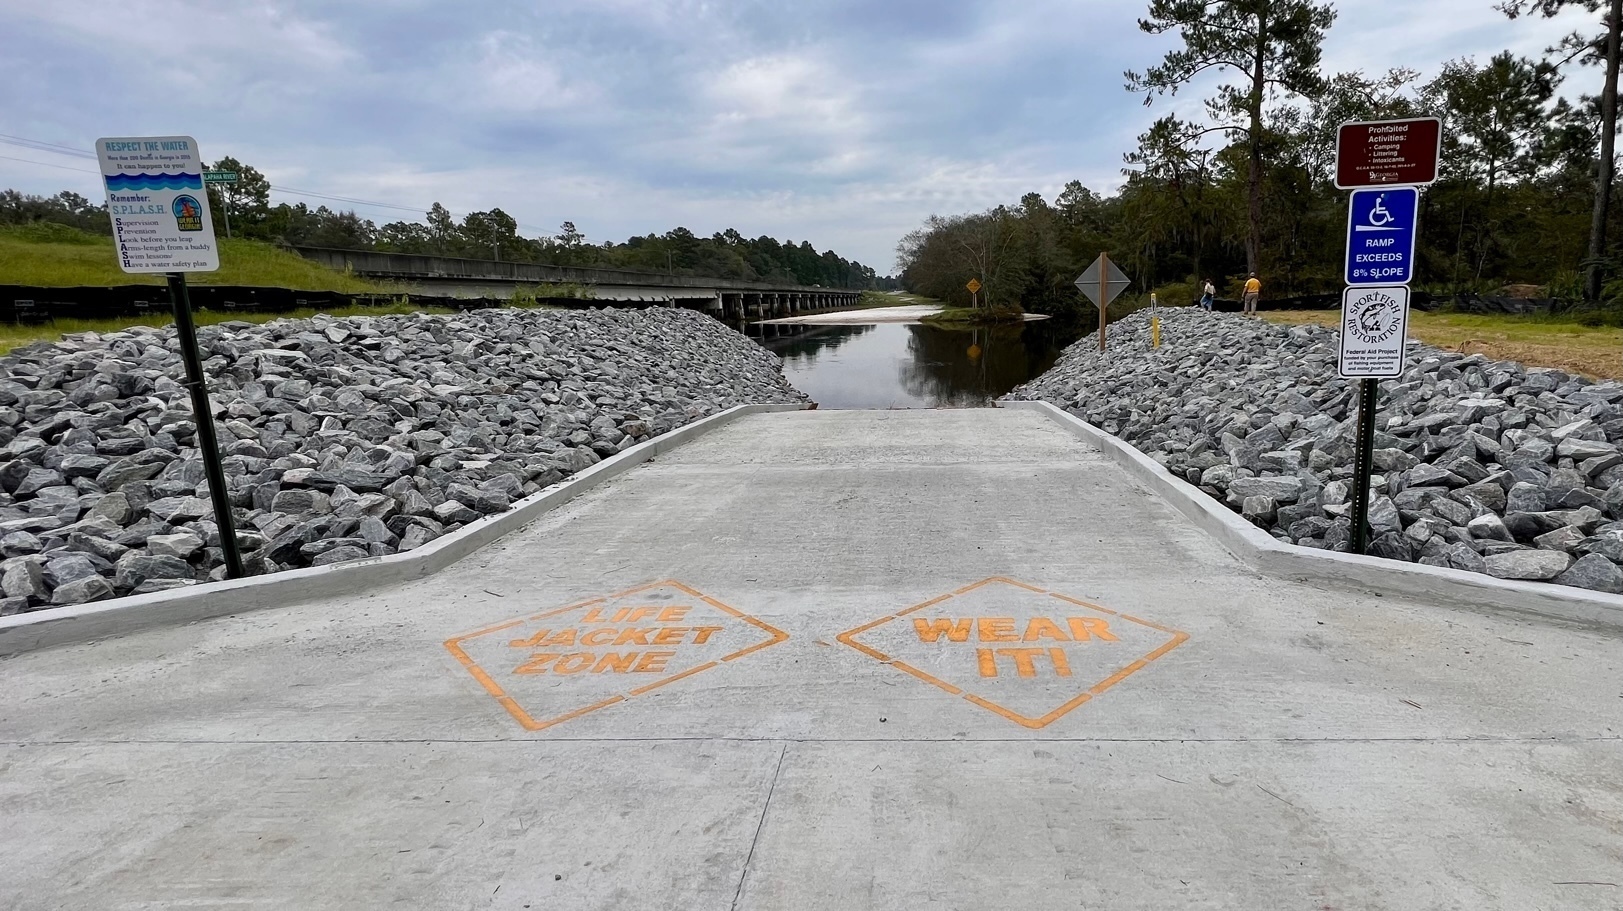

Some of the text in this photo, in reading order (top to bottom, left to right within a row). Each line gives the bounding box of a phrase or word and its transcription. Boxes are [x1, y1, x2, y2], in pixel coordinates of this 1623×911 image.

[1368, 125, 1408, 133] Prohibited
[106, 141, 188, 151] RESPECT THE WATER
[111, 194, 150, 202] Remember:
[113, 205, 167, 214] S.P.L.A.S.H.
[116, 218, 159, 226] Supervision
[121, 243, 165, 251] Arms-length
[1366, 239, 1394, 247] RAMP
[1356, 253, 1403, 262] EXCEEDS
[193, 260, 207, 268] plan
[1353, 268, 1403, 277] 8% SLOPE
[1350, 292, 1400, 315] SPORT FISH
[1348, 317, 1400, 343] RESTORATION
[581, 606, 693, 623] LIFE
[912, 617, 1121, 643] WEAR
[508, 626, 723, 648] JACKET
[511, 650, 677, 675] ZONE
[976, 647, 1073, 678] IT!
